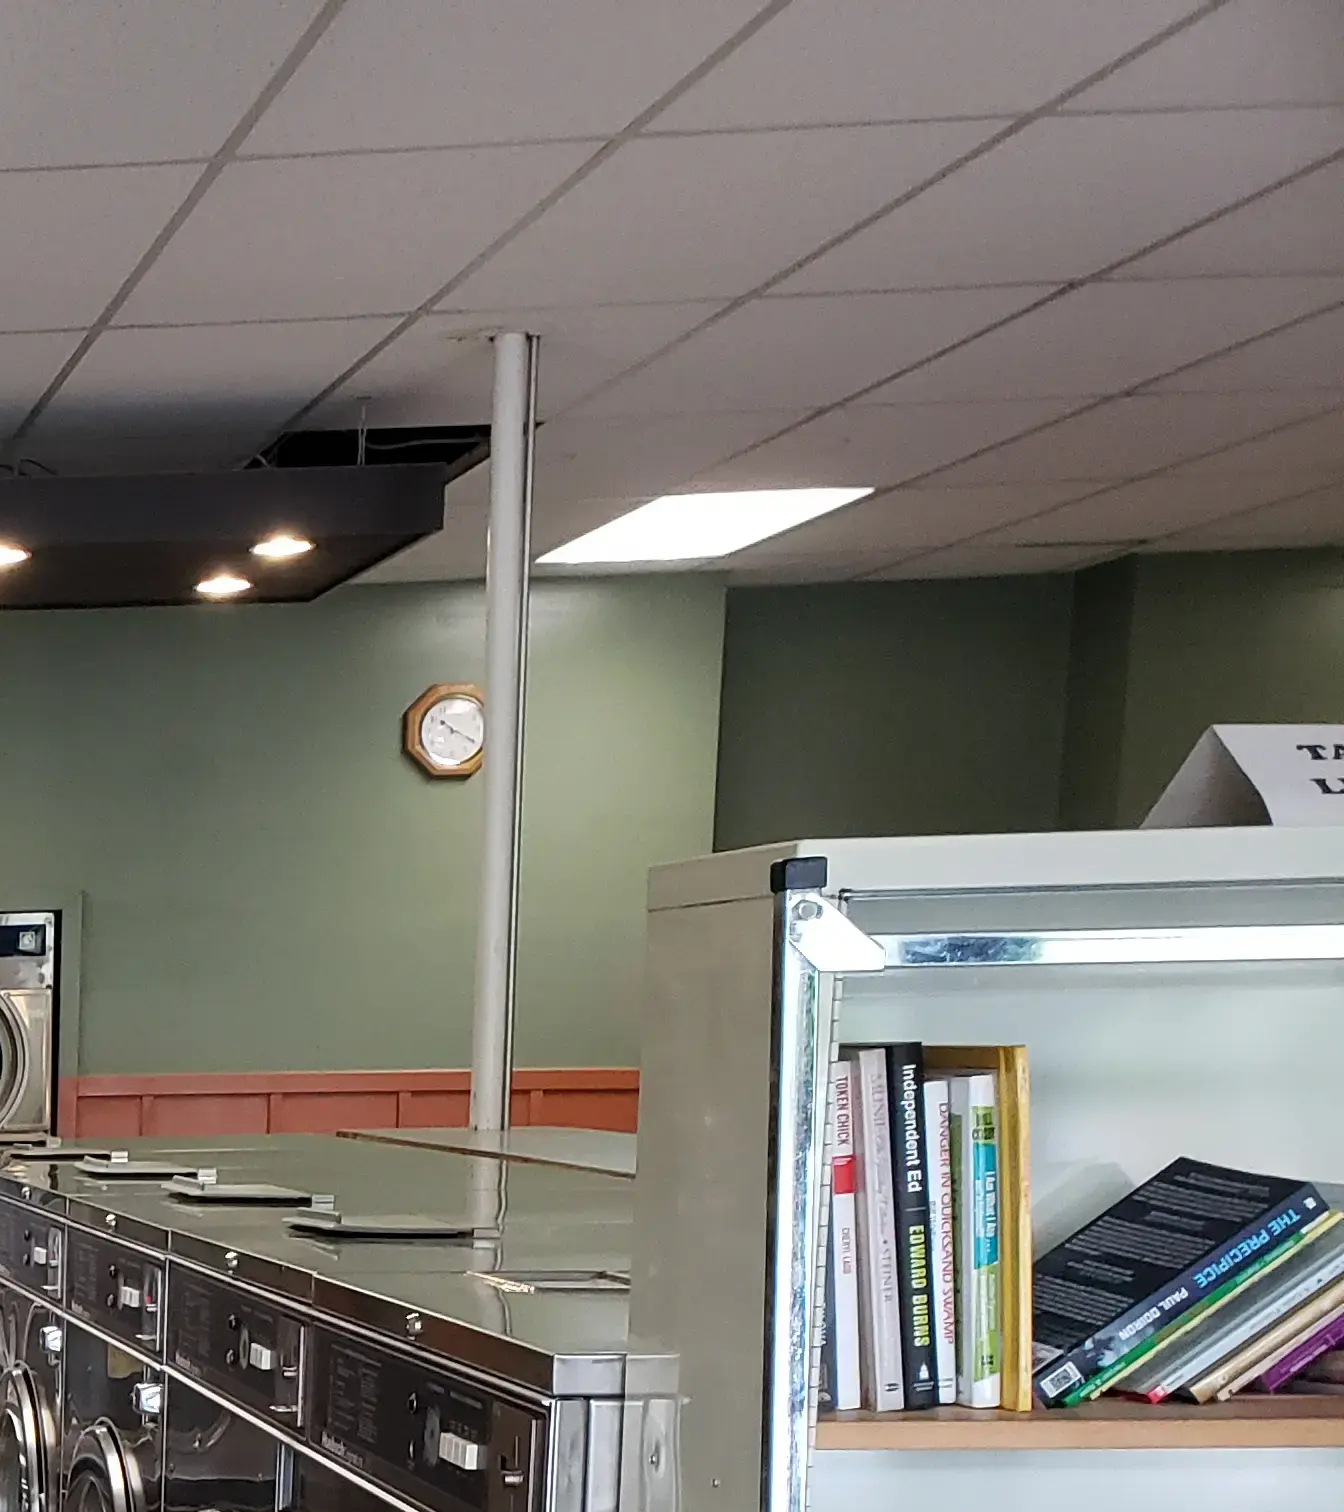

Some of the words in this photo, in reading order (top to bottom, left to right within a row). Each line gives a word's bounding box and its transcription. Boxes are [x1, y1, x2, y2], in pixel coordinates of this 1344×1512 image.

[835, 1075, 850, 1111] TOKEN
[836, 1114, 851, 1146] CHICK
[900, 1064, 921, 1167] Independent
[938, 1102, 951, 1169] DANGER
[907, 1170, 923, 1193] Ed
[940, 1172, 952, 1188] IN
[940, 1193, 953, 1284] QUICKSAND
[1268, 1208, 1301, 1236] THE
[909, 1224, 928, 1289] EDWARD
[1192, 1233, 1270, 1289] PRECIPICE
[912, 1294, 931, 1347] BURNS
[941, 1288, 954, 1344] SWAMP
[1157, 1287, 1189, 1311] PAUL
[1118, 1308, 1161, 1341] DOIRON
